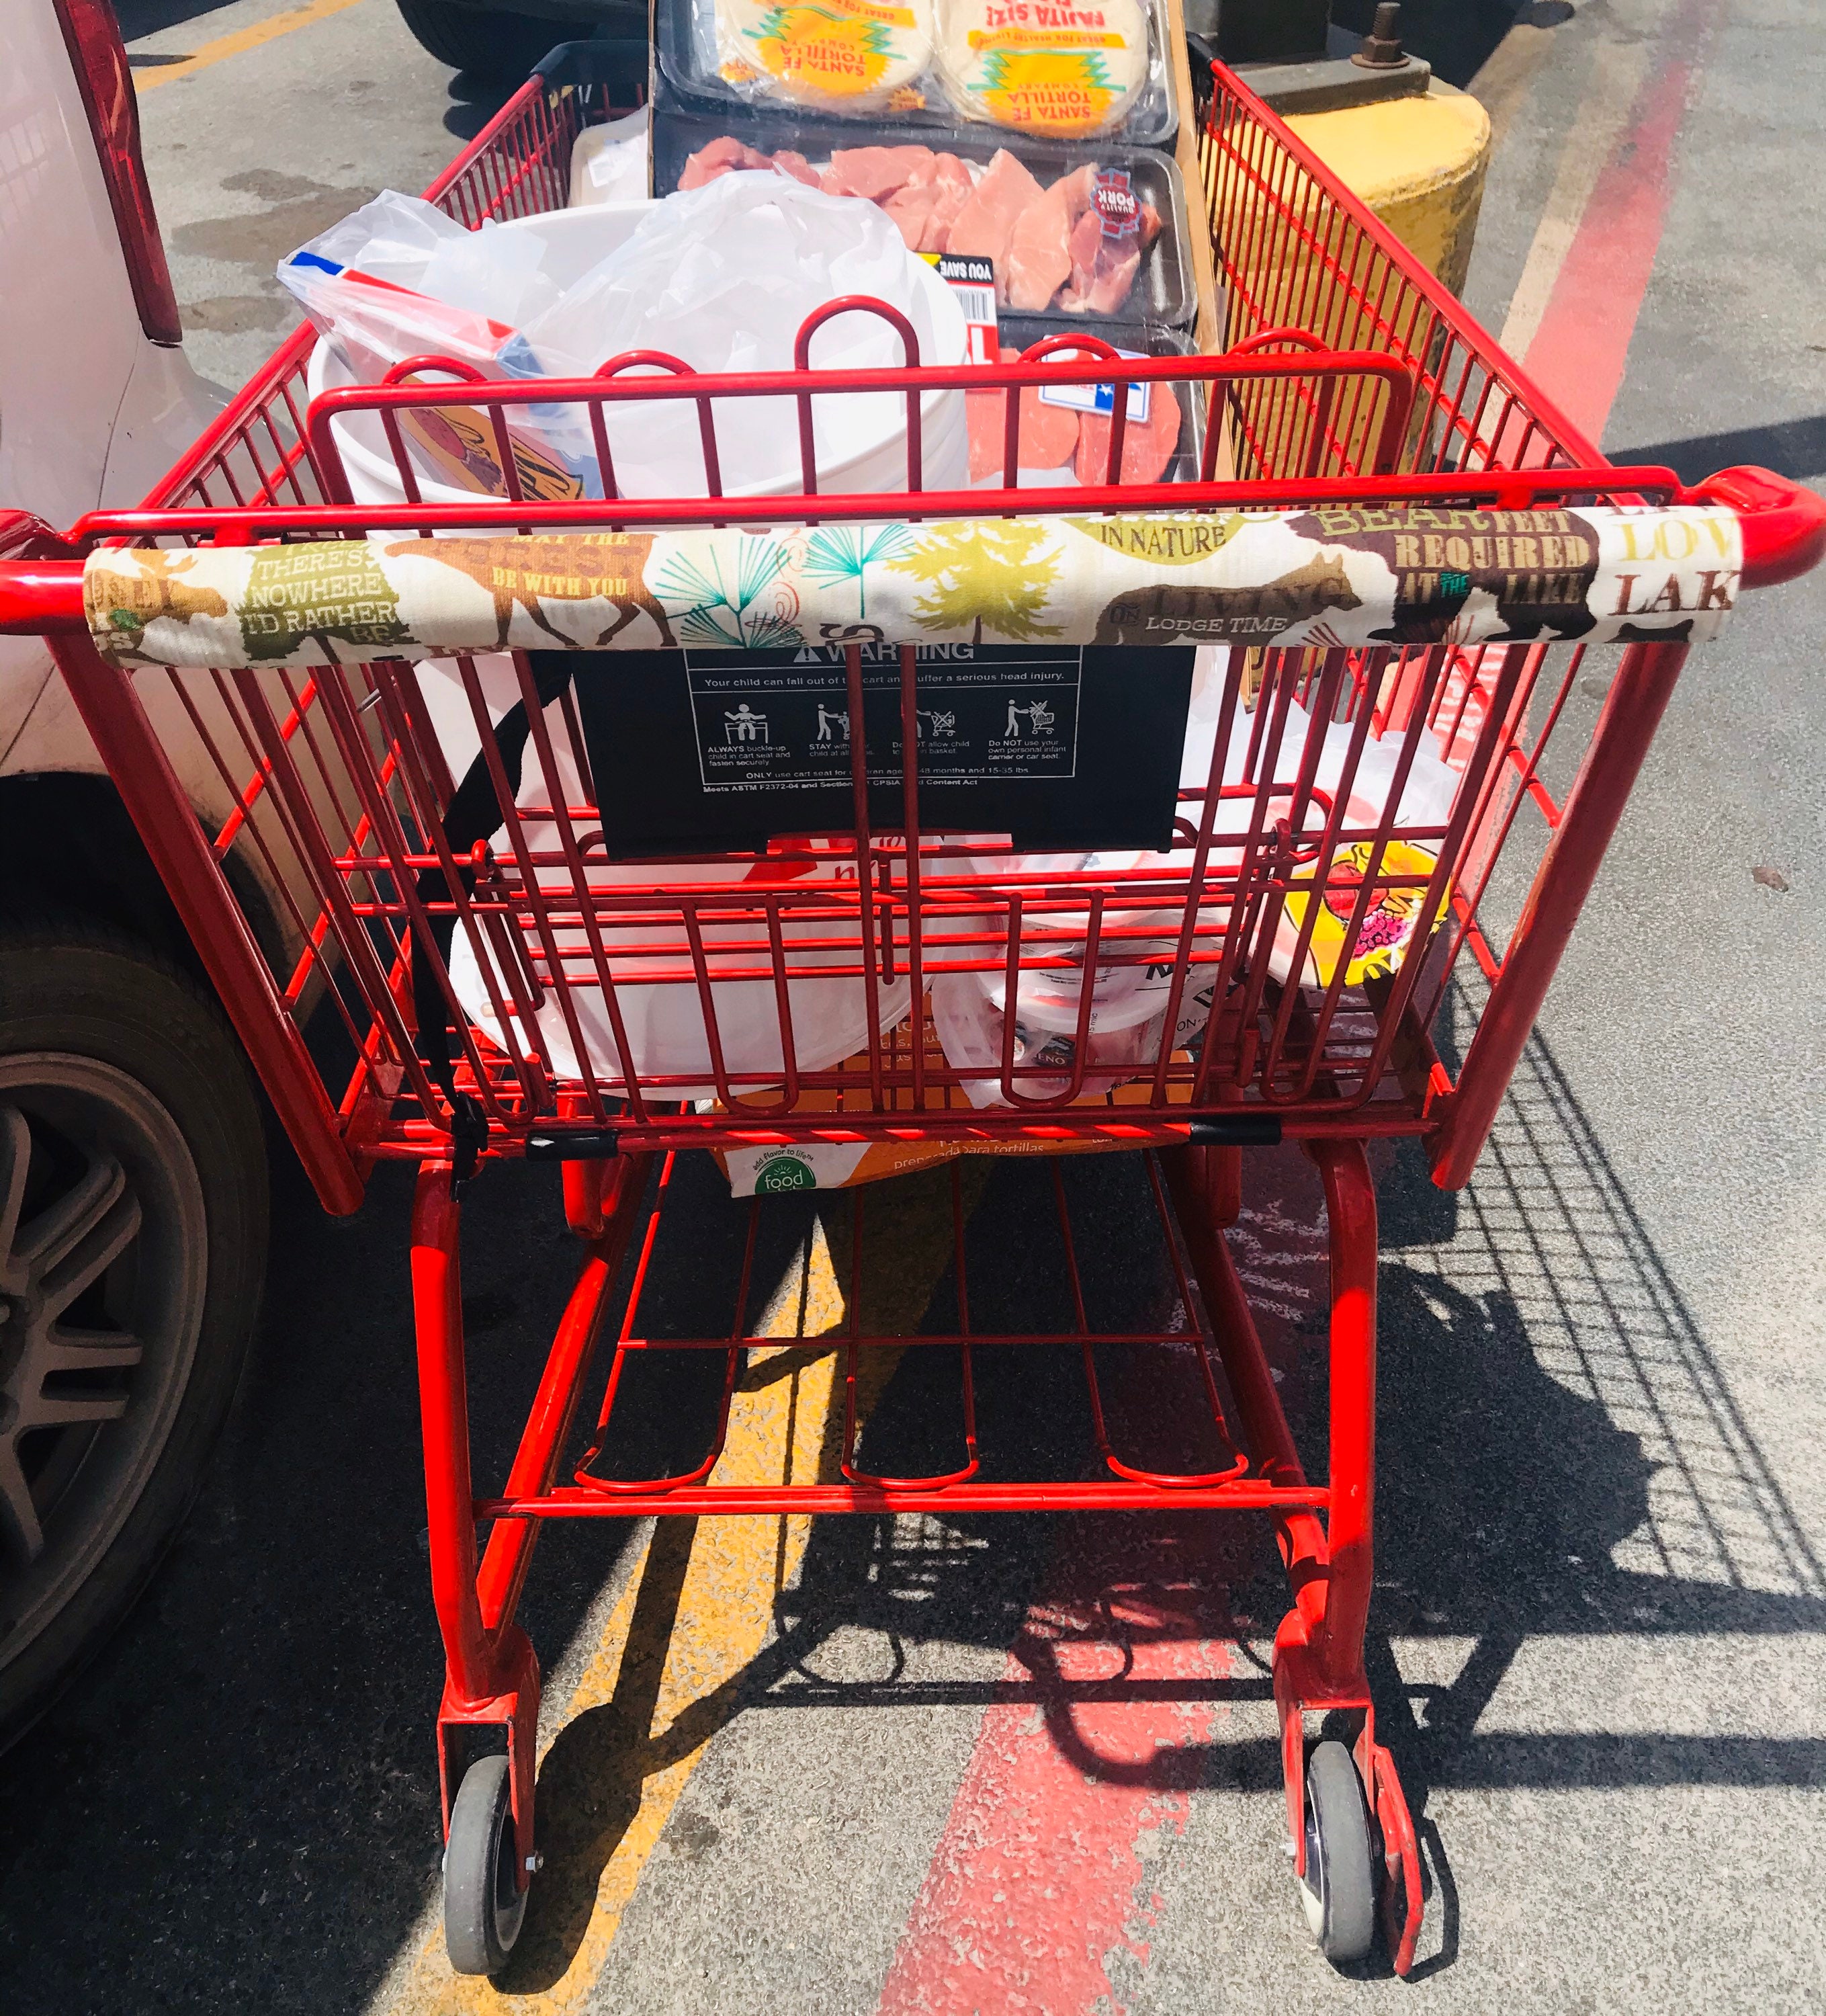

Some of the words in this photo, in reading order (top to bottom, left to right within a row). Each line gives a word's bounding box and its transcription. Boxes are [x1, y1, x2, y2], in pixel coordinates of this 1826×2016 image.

[1035, 5, 1106, 28] FAJITA
[780, 45, 867, 66] TORTILLA
[782, 56, 802, 70] FE
[806, 59, 866, 77] SANTA
[1006, 91, 1092, 104] TORTILLA
[1011, 106, 1031, 122] FE
[1039, 105, 1091, 121] SANTA
[1097, 189, 1136, 208] PORK
[939, 260, 968, 278] SAVE
[968, 261, 992, 281] YOU
[1101, 524, 1123, 548] IN
[1130, 525, 1227, 558] NATURE
[1394, 535, 1590, 571] REQUIRED
[257, 549, 363, 581] THERE'S
[250, 573, 382, 609] NOWHERE
[492, 566, 517, 589] BE
[523, 572, 582, 596] WITH
[587, 577, 628, 596] YOU
[245, 613, 280, 634] I'D
[283, 601, 396, 633] RATHER
[1145, 616, 1224, 633] LODGE
[1228, 616, 1288, 635] TIME
[705, 678, 730, 687] Your
[733, 677, 760, 687] child
[763, 678, 783, 686] can
[786, 677, 803, 685] fall
[807, 677, 825, 685] out
[828, 676, 839, 685] of
[863, 676, 883, 684] cart
[917, 674, 943, 683] uffer
[956, 673, 997, 682] serious
[1000, 672, 1027, 681] head
[1031, 672, 1065, 681] injury.
[994, 1142, 1044, 1154] tortillas
[752, 1158, 765, 1171] add
[763, 1148, 785, 1161] flavor
[764, 1169, 803, 1189] food
